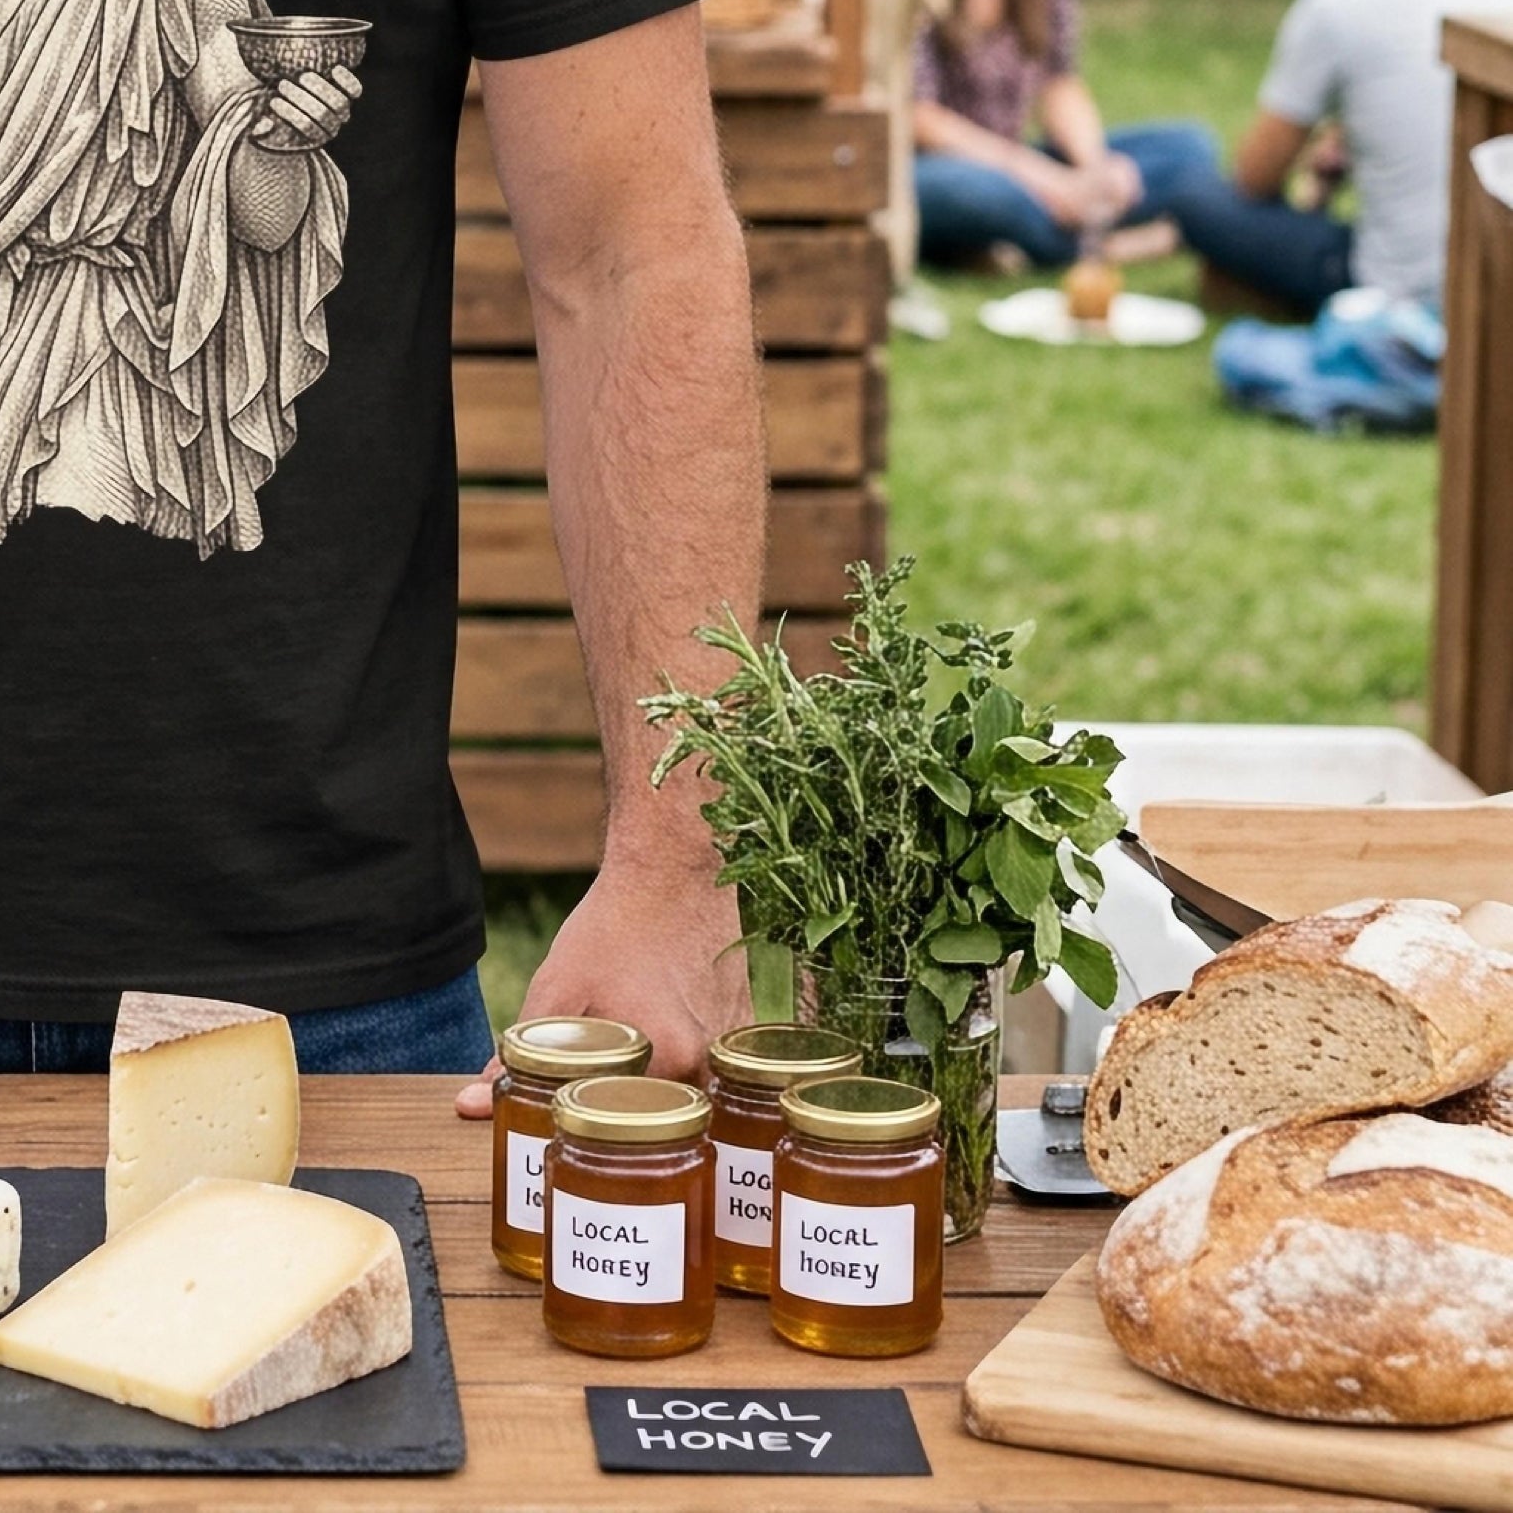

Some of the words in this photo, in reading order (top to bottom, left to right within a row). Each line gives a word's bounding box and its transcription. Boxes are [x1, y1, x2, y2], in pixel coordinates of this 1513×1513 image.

[571, 1215, 650, 1245] LOCAL
[626, 1397, 822, 1423] LOCAL
[635, 1426, 834, 1460] HONEY
